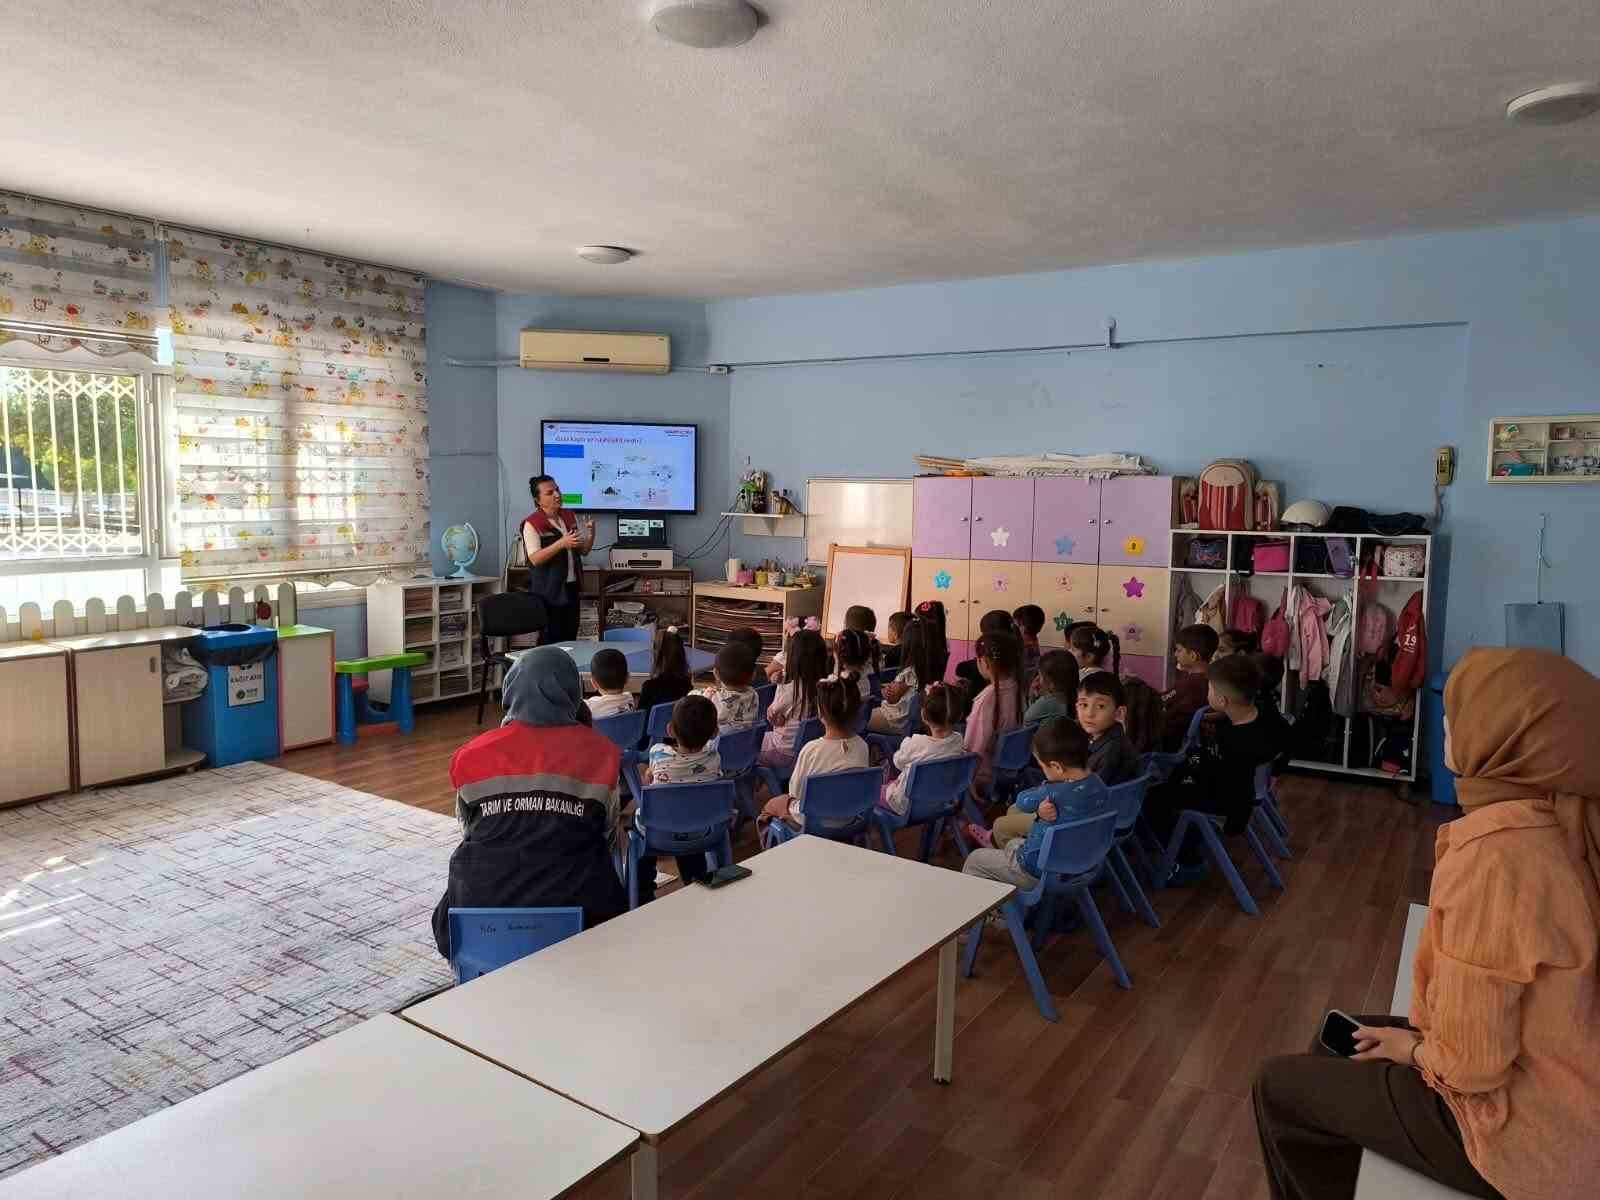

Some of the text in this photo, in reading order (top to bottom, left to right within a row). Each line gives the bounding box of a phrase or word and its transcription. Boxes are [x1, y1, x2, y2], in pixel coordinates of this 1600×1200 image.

[480, 797, 585, 817] TARIM VE ORMAN BAKANLIĞI
